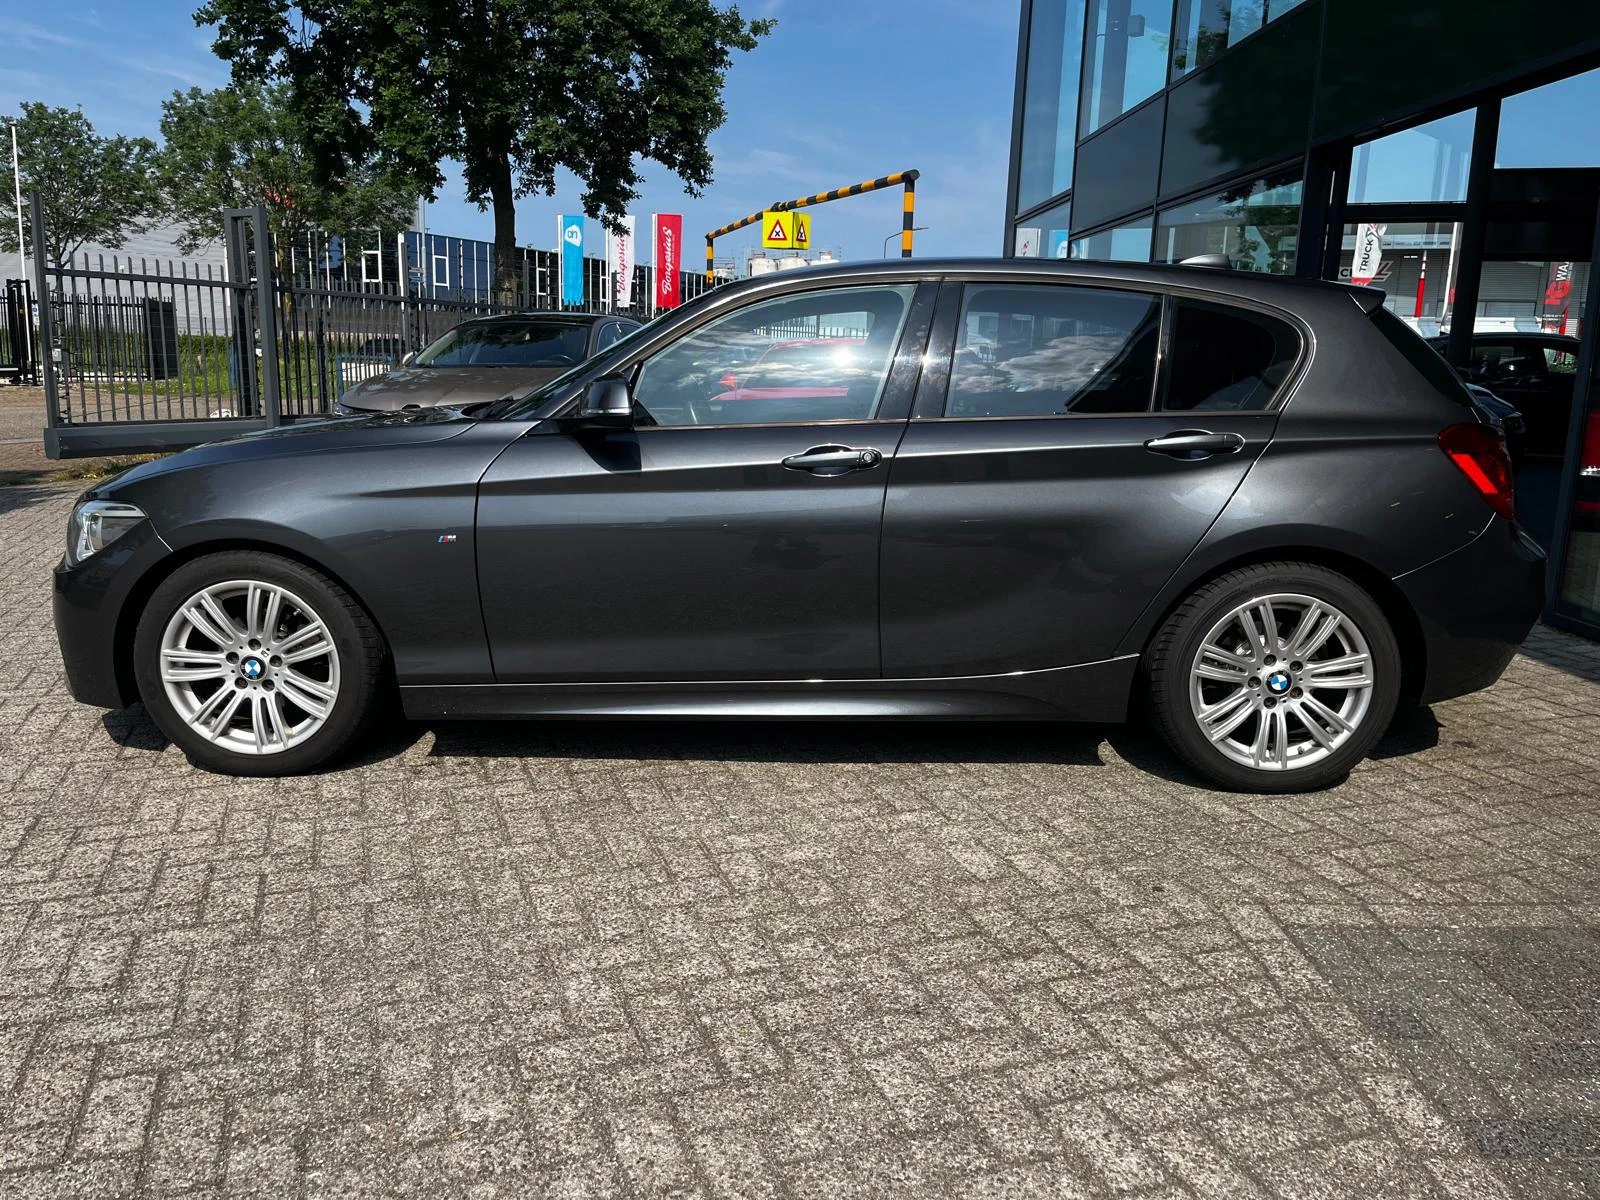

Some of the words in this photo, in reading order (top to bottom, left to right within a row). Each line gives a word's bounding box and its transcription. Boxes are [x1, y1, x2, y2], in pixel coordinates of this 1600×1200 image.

[616, 235, 627, 294] Borgesiu
[661, 227, 673, 294] Borgesius
[1359, 239, 1374, 273] TRUCK
[1555, 261, 1569, 281] WA
